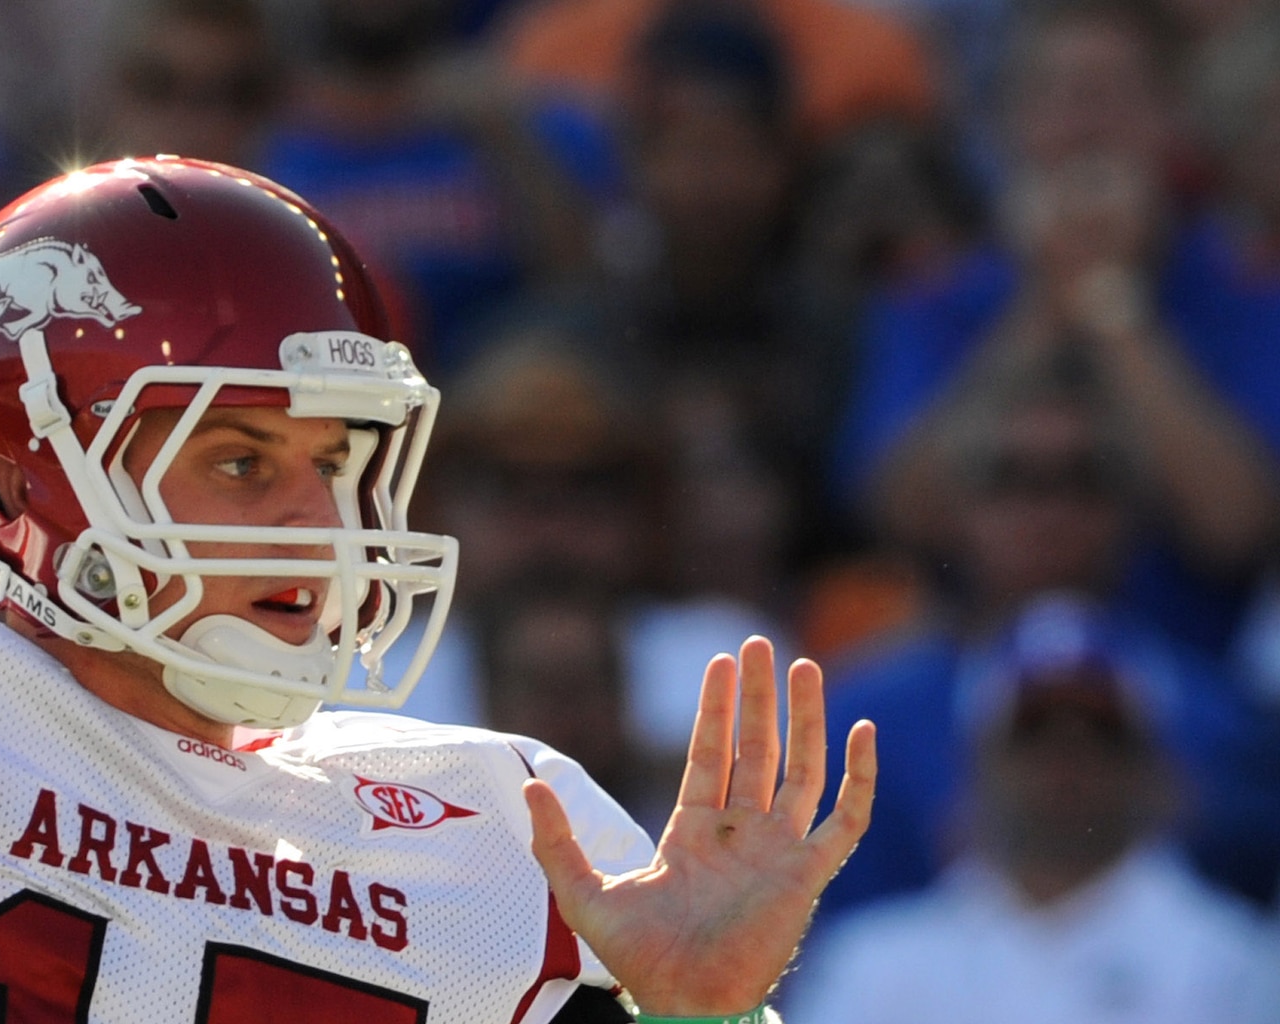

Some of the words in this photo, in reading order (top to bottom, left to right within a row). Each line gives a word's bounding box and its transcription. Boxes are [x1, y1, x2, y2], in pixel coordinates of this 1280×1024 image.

[327, 338, 375, 367] HOGS
[176, 738, 247, 772] adidas
[371, 785, 426, 824] SEC
[9, 787, 409, 953] ARKANSAS
